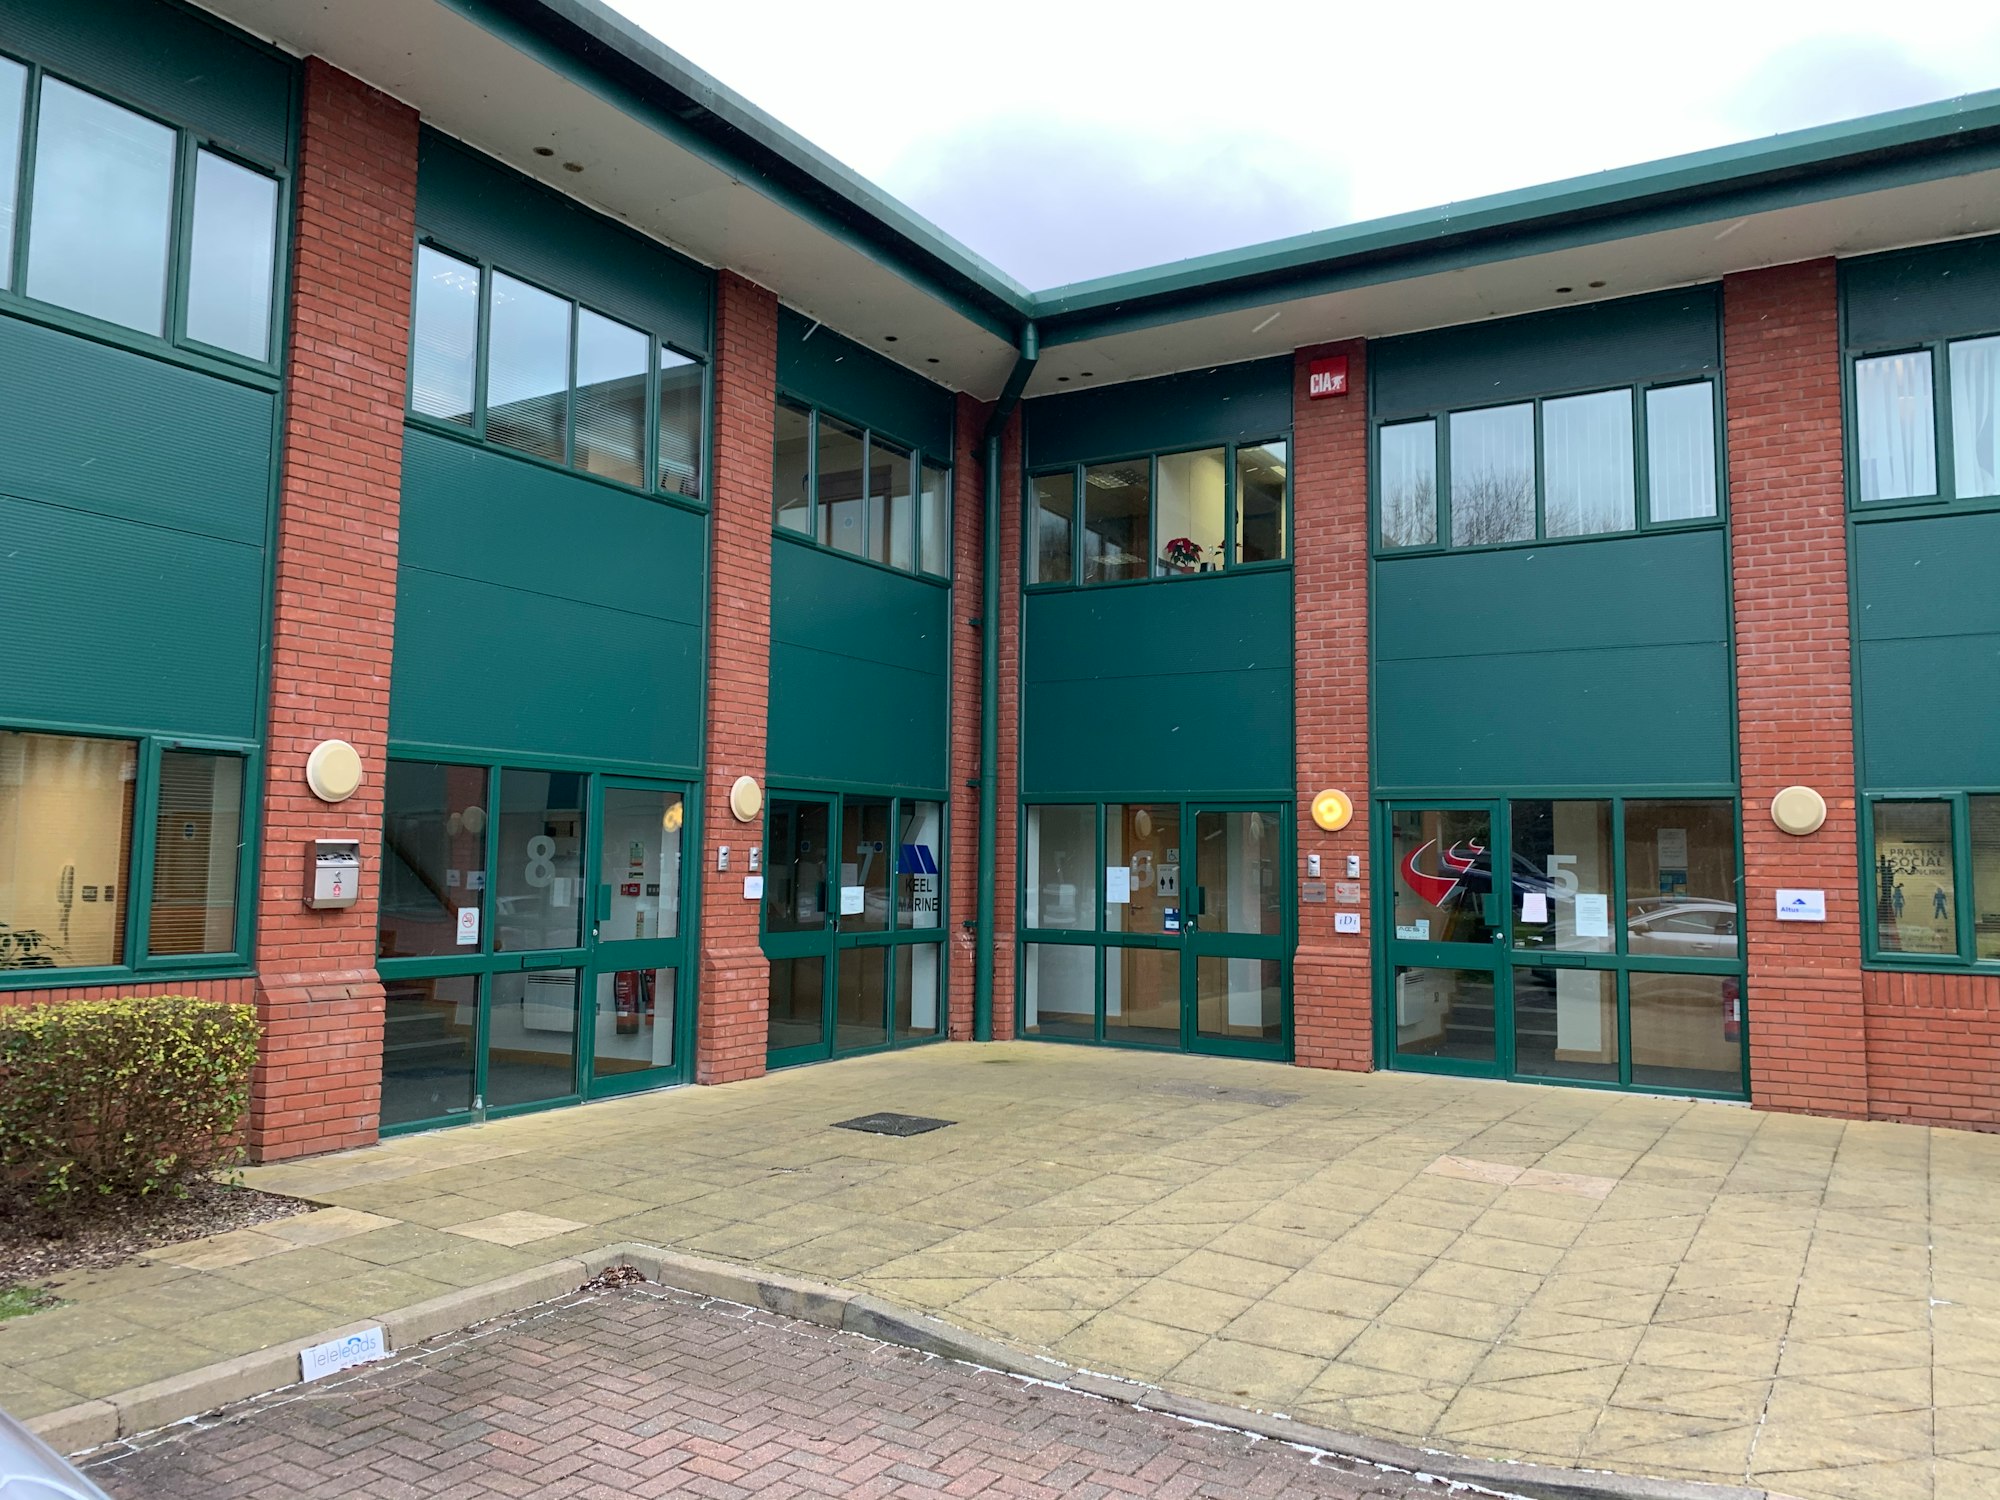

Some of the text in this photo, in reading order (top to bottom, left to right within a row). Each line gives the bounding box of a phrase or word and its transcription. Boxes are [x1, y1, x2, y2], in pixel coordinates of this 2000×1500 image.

[1310, 372, 1331, 393] CIA
[525, 835, 556, 887] 8
[856, 845, 875, 886] 7
[1889, 848, 1945, 857] PRACTICE
[1891, 857, 1945, 867] SOCIAL
[1130, 850, 1155, 888] 6
[1546, 855, 1579, 898] 5
[905, 878, 932, 892] KEEL
[898, 898, 939, 912] MARINE
[309, 1333, 376, 1368] Teleleads
